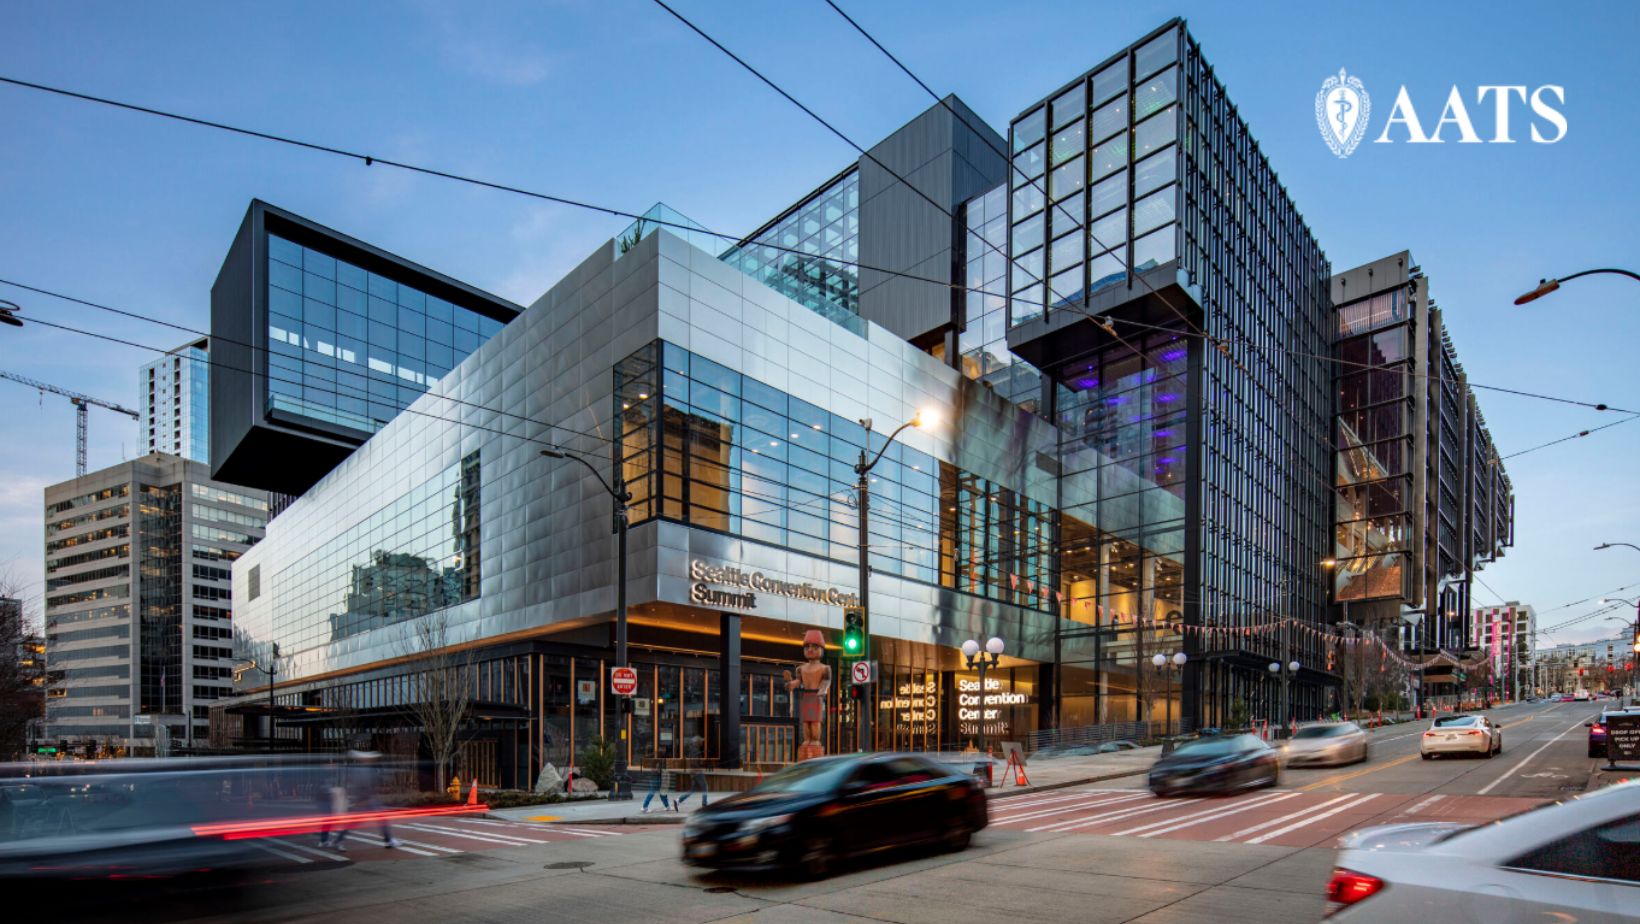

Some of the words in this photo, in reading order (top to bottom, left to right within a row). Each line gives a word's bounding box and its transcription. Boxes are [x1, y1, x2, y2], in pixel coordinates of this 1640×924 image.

[692, 559, 749, 588] Seattle
[749, 571, 827, 604] Convention
[826, 587, 861, 607] Cent
[692, 582, 757, 610] Summit
[959, 679, 1000, 692] Seatle
[959, 707, 999, 720] Cener
